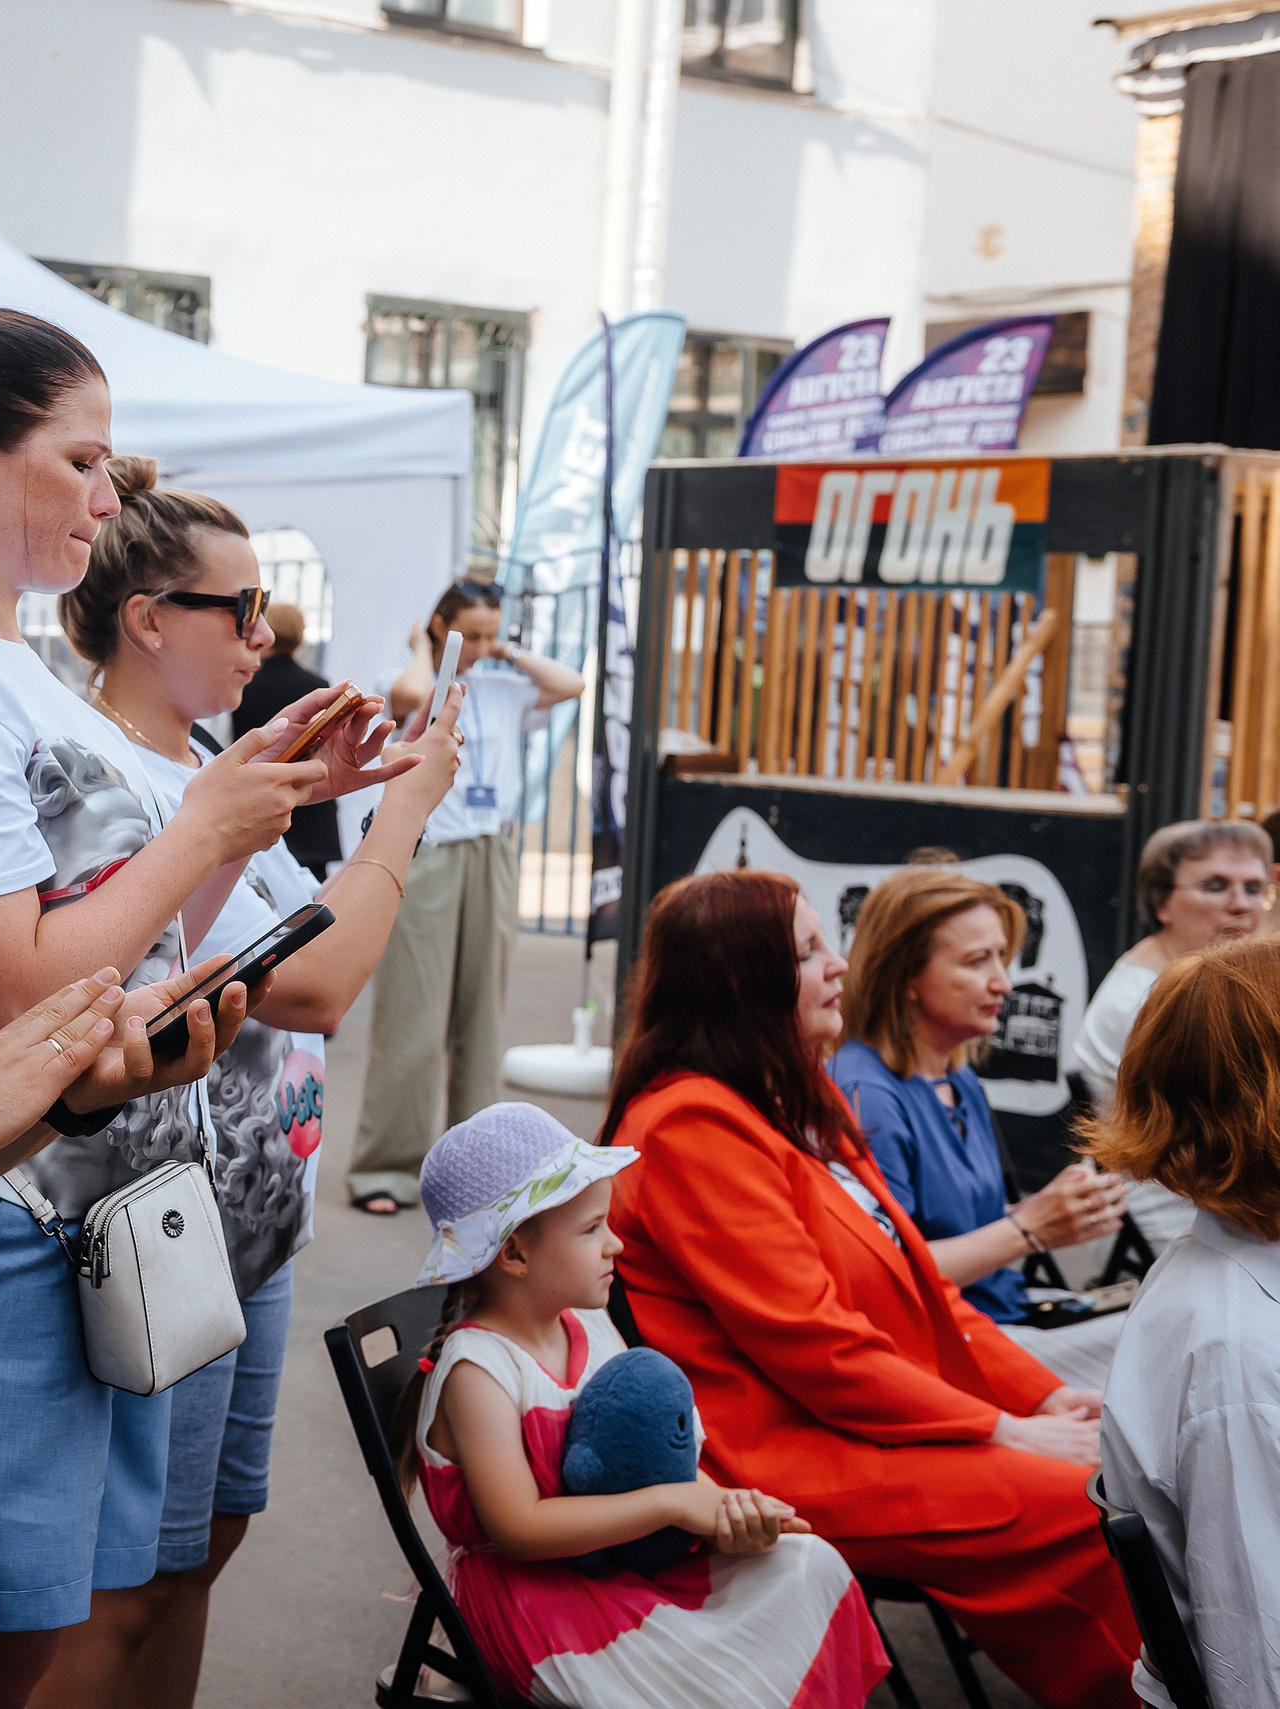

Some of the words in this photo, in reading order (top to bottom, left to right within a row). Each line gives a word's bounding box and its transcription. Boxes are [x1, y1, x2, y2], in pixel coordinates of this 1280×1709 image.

[839, 334, 880, 368] 23
[978, 336, 1033, 372] 23
[805, 468, 1015, 583] ОГОНЬ
